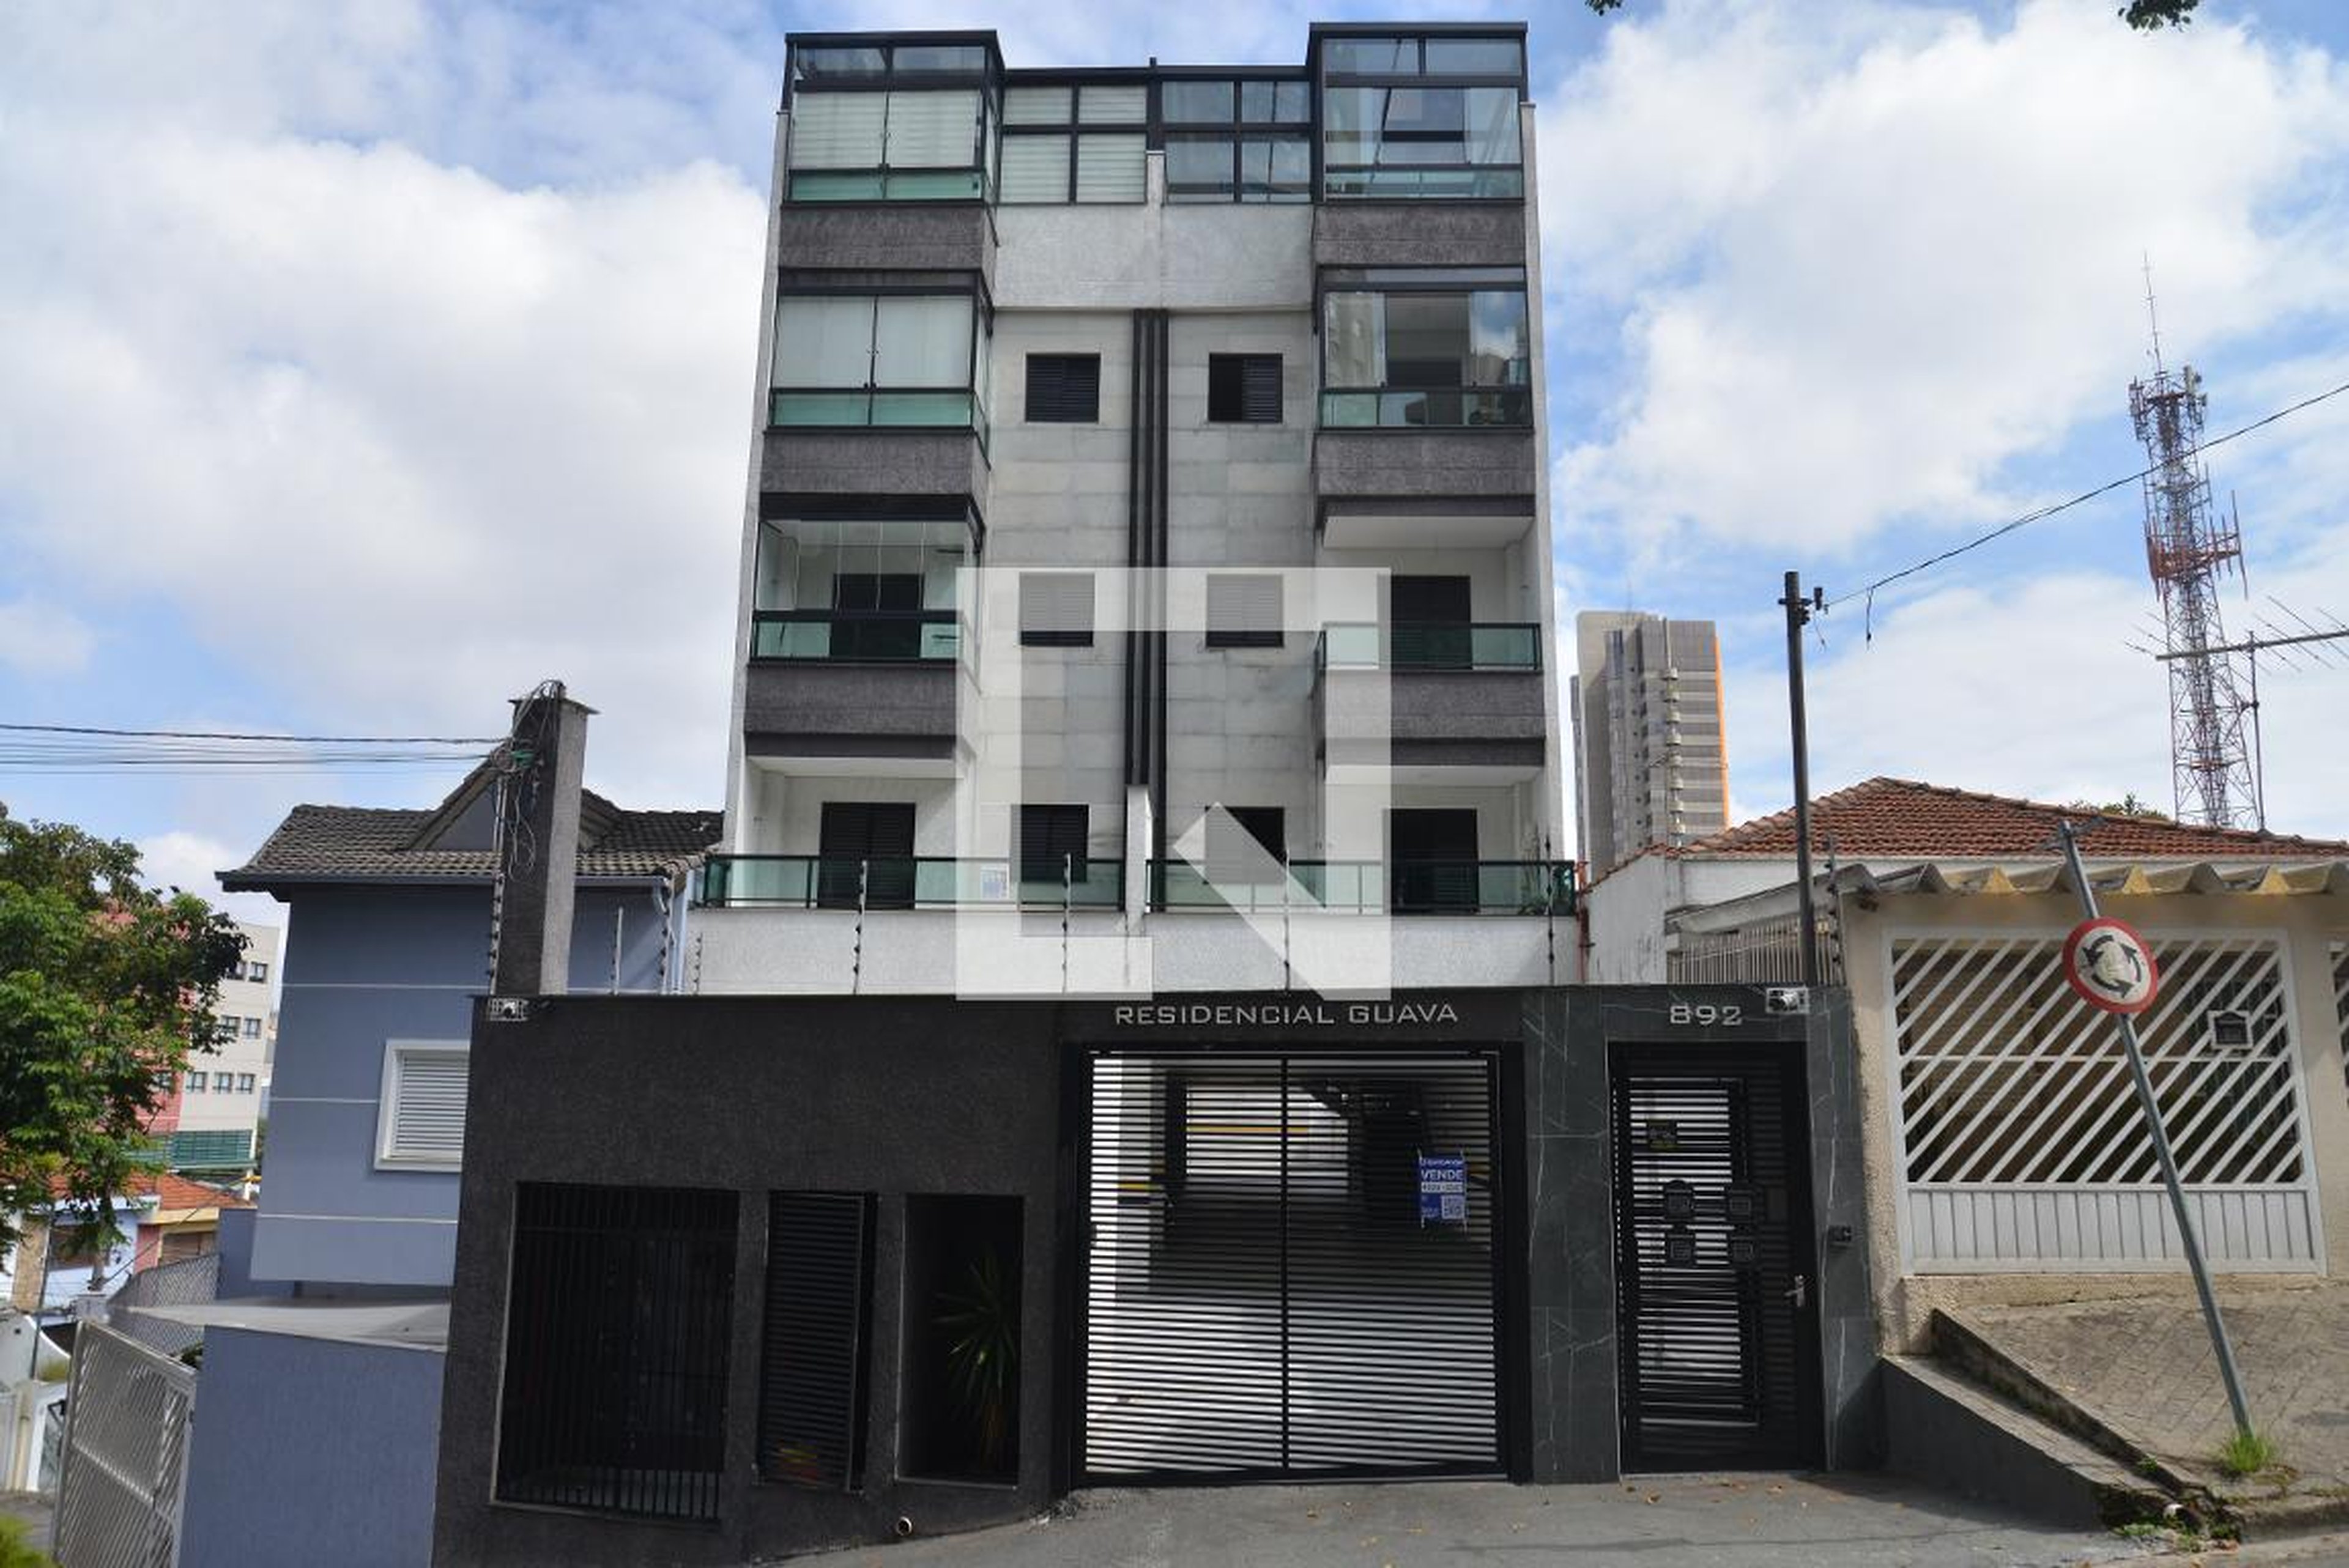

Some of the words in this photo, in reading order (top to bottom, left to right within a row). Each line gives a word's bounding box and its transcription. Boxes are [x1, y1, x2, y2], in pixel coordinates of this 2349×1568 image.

[1116, 1005, 1335, 1025] RESIDENCIAL
[1348, 1004, 1458, 1023] GUAVA
[1669, 1005, 1742, 1026] 892
[1421, 1169, 1463, 1180] VENDE
